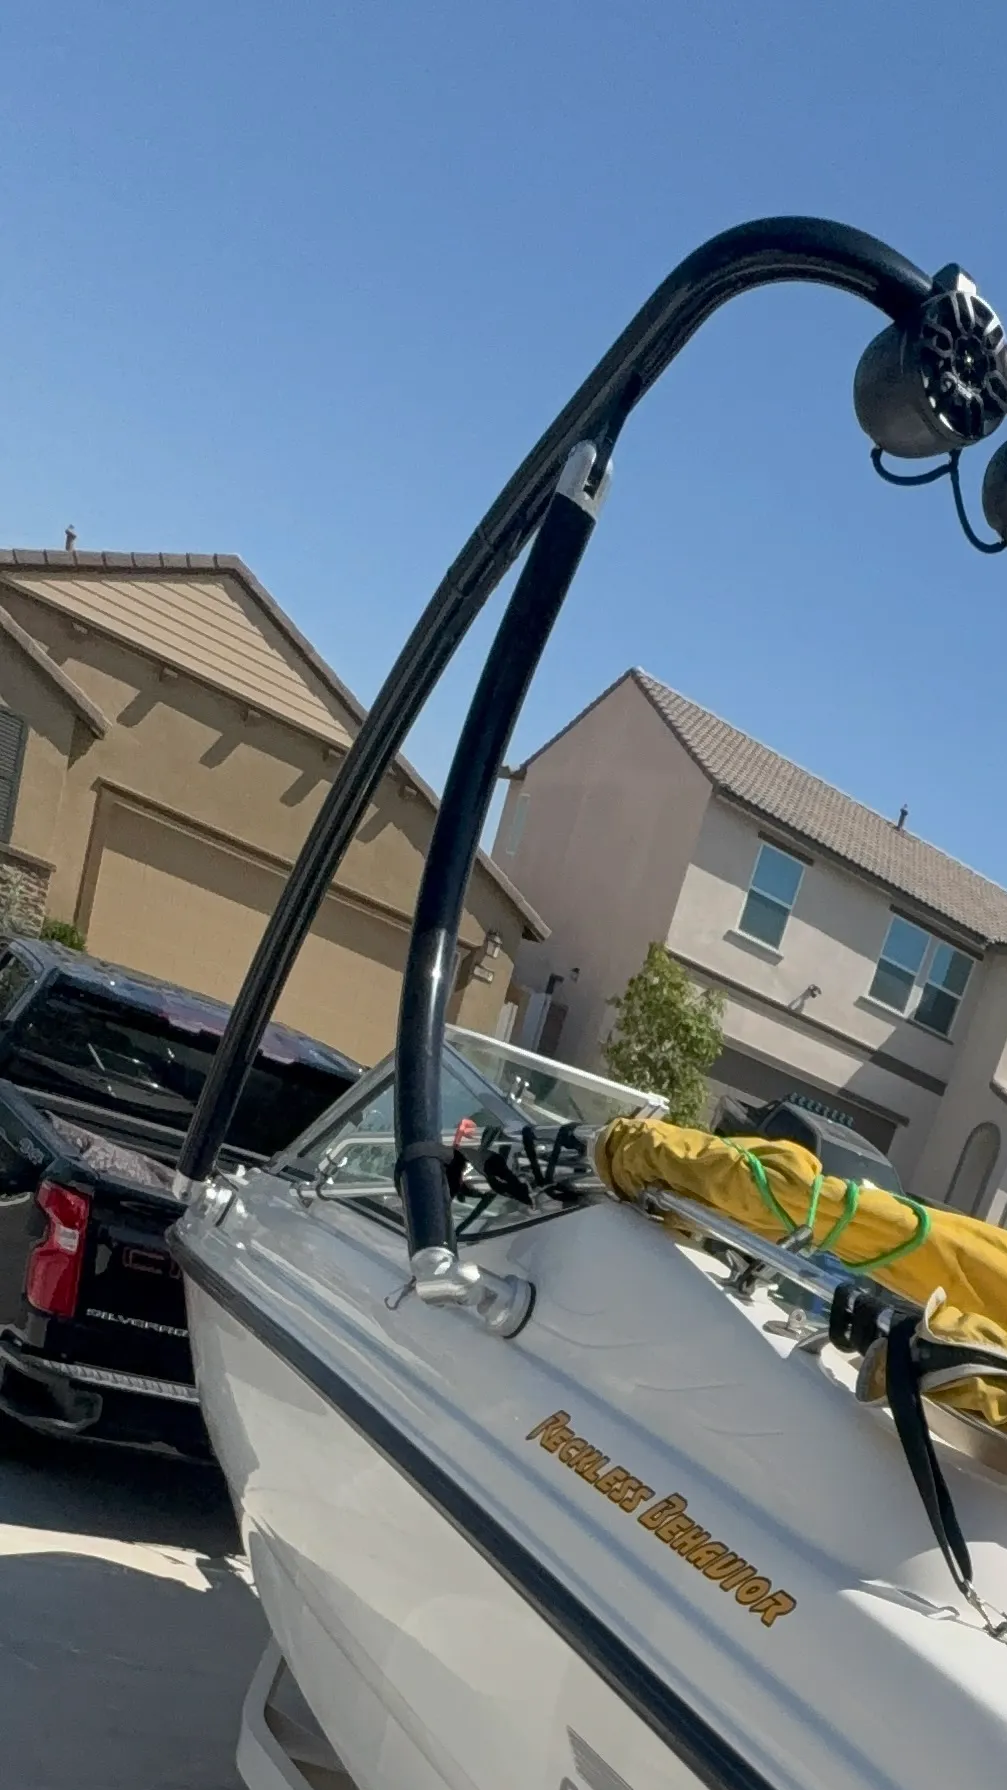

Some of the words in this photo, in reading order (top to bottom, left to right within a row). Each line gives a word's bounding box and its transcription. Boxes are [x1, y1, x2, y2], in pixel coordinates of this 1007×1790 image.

[86, 1308, 188, 1337] SILVERAD
[525, 1410, 656, 1513] RECKLESS
[637, 1492, 797, 1627] BEHAVIOR
